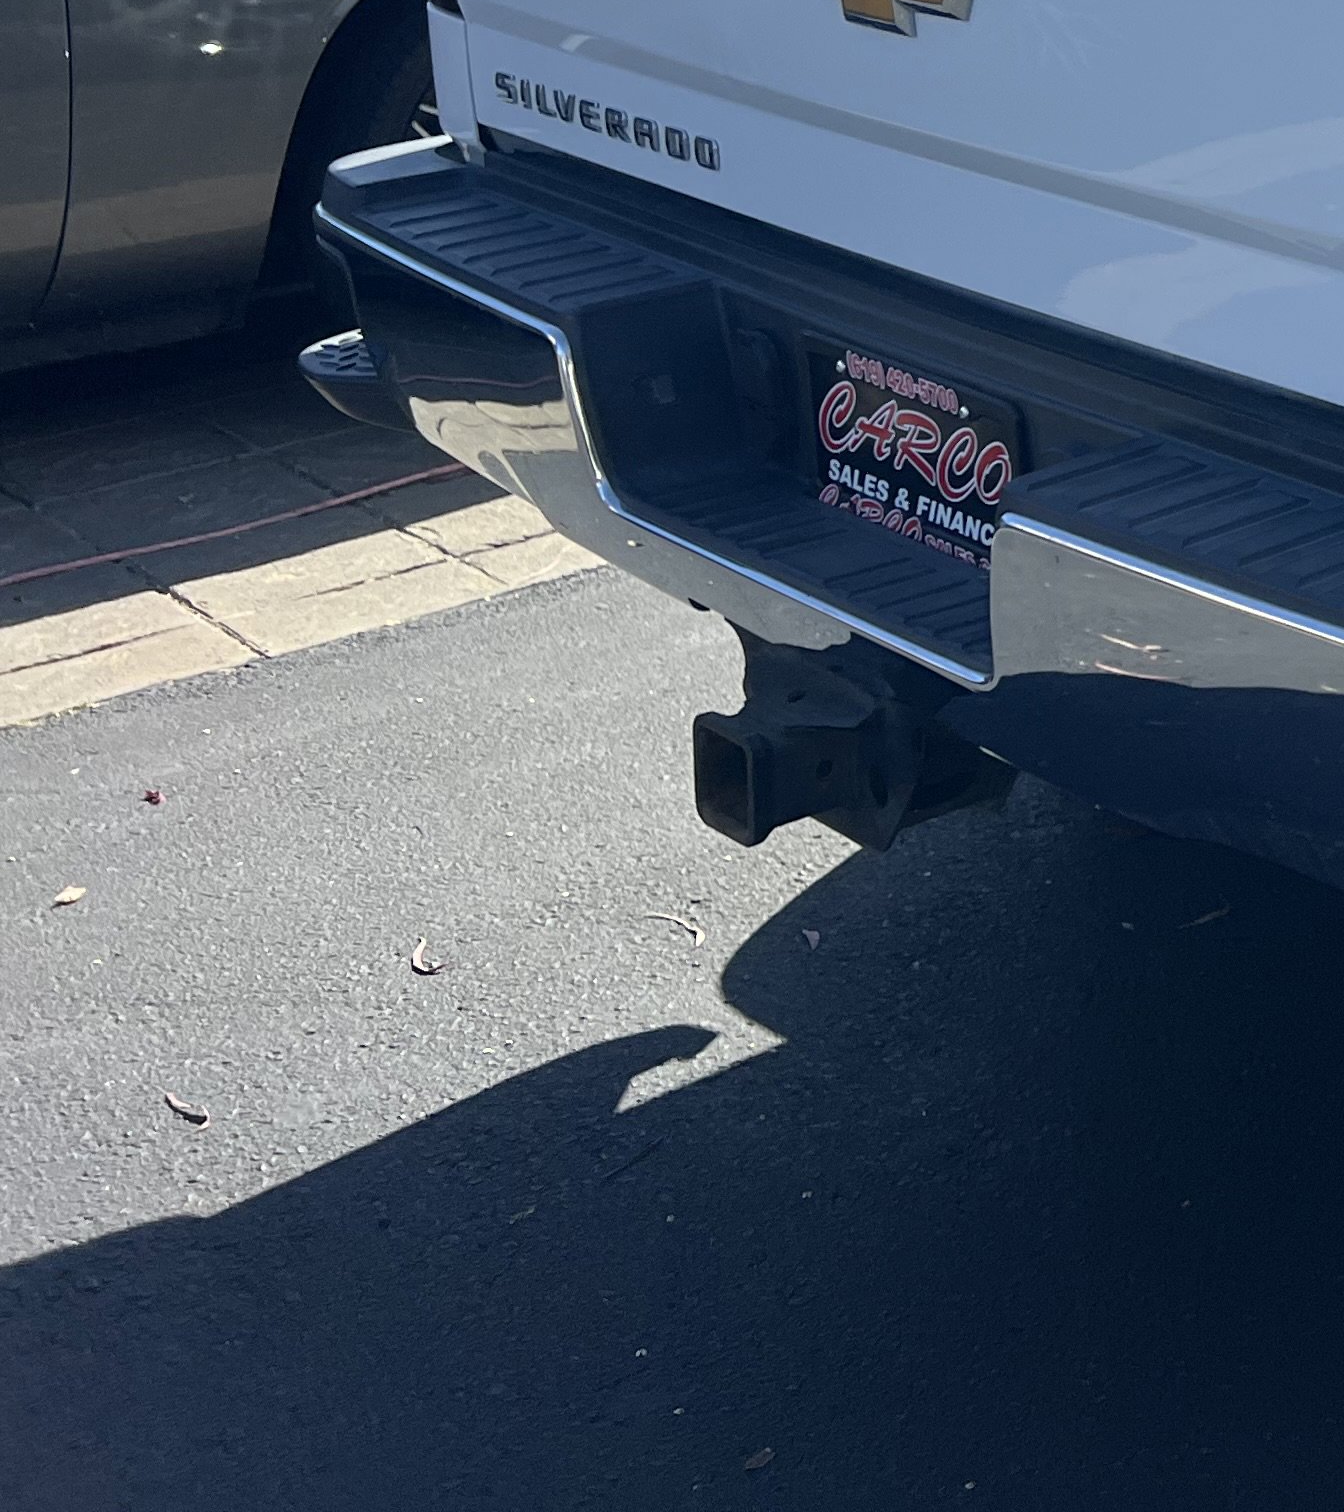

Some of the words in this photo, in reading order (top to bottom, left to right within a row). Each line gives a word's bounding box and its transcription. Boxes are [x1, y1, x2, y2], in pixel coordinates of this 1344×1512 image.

[495, 72, 720, 171] SILVERADO
[819, 380, 1012, 505] CARCO
[828, 459, 889, 502] SALES
[894, 488, 910, 511] &
